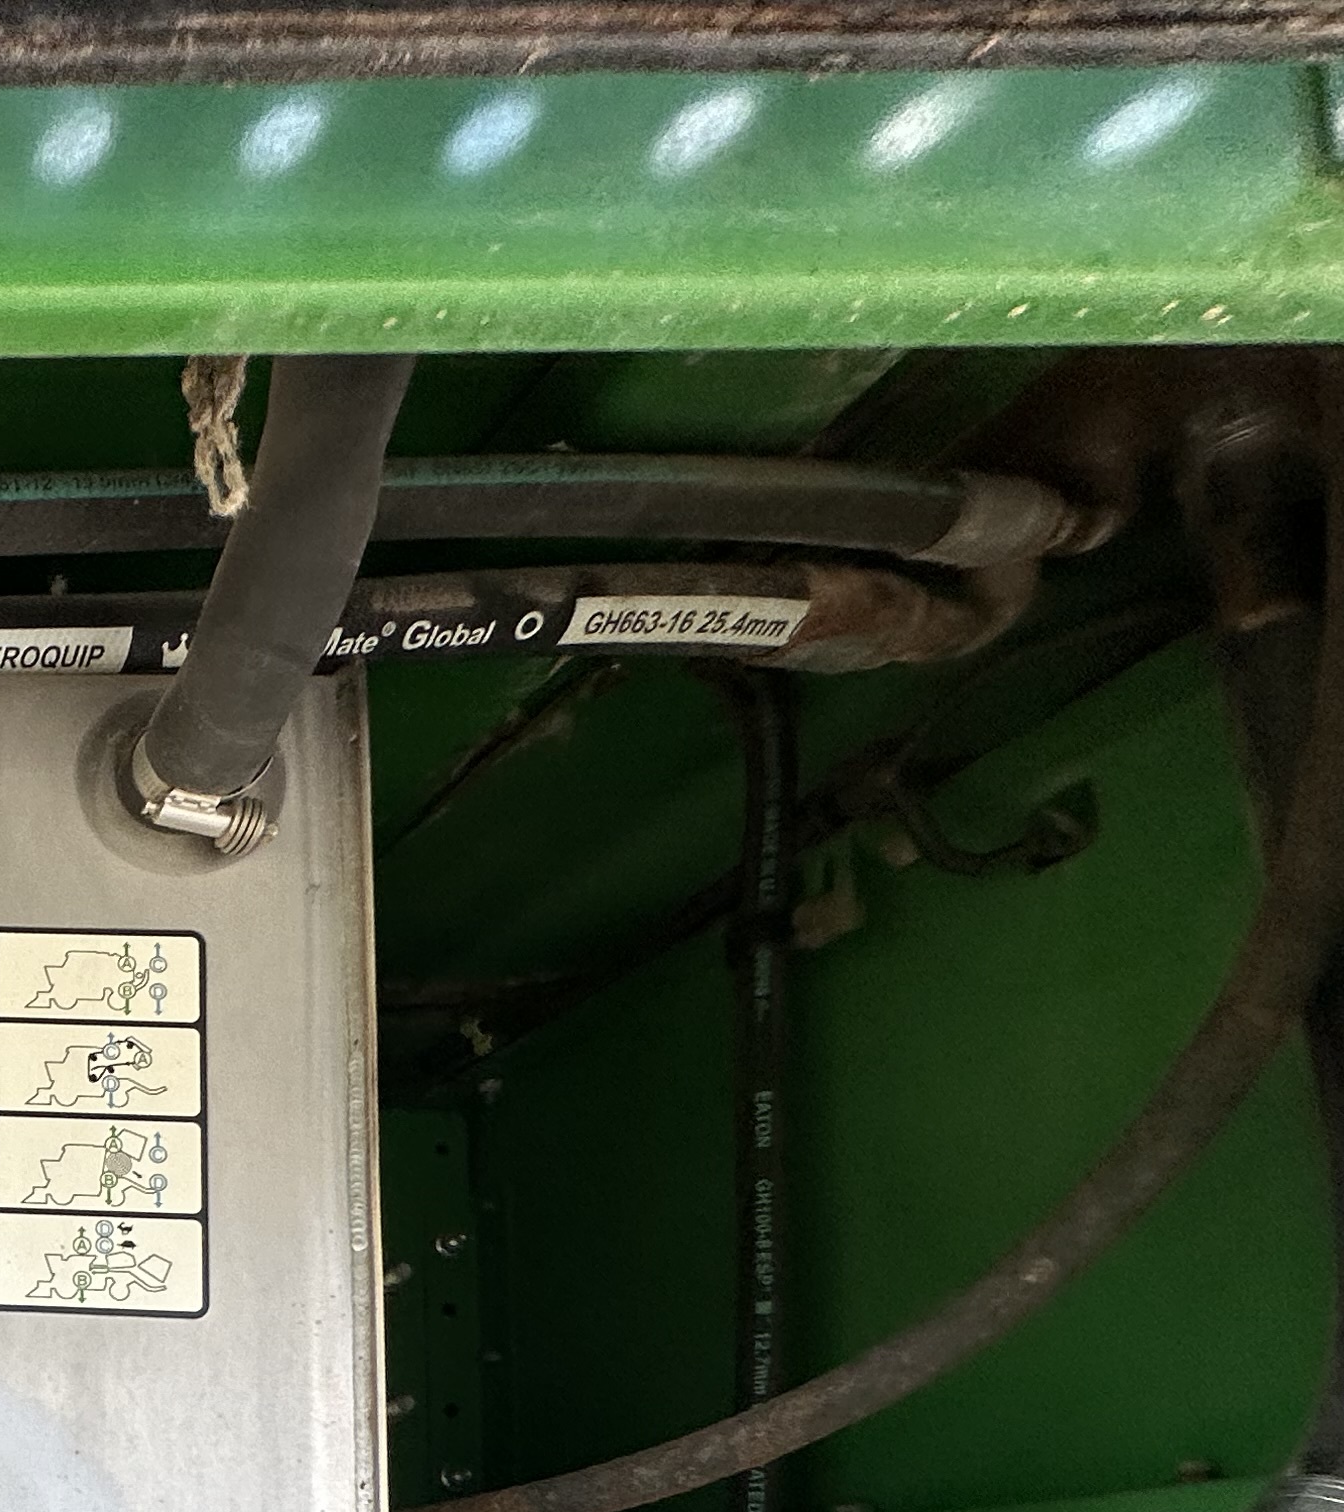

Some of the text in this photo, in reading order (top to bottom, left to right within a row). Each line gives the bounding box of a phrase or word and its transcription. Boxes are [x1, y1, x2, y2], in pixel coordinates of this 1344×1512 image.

[401, 618, 495, 651] Global
[584, 608, 695, 638] GH663-16
[697, 609, 790, 639] 25.4mm
[754, 1090, 775, 1149] EATON
